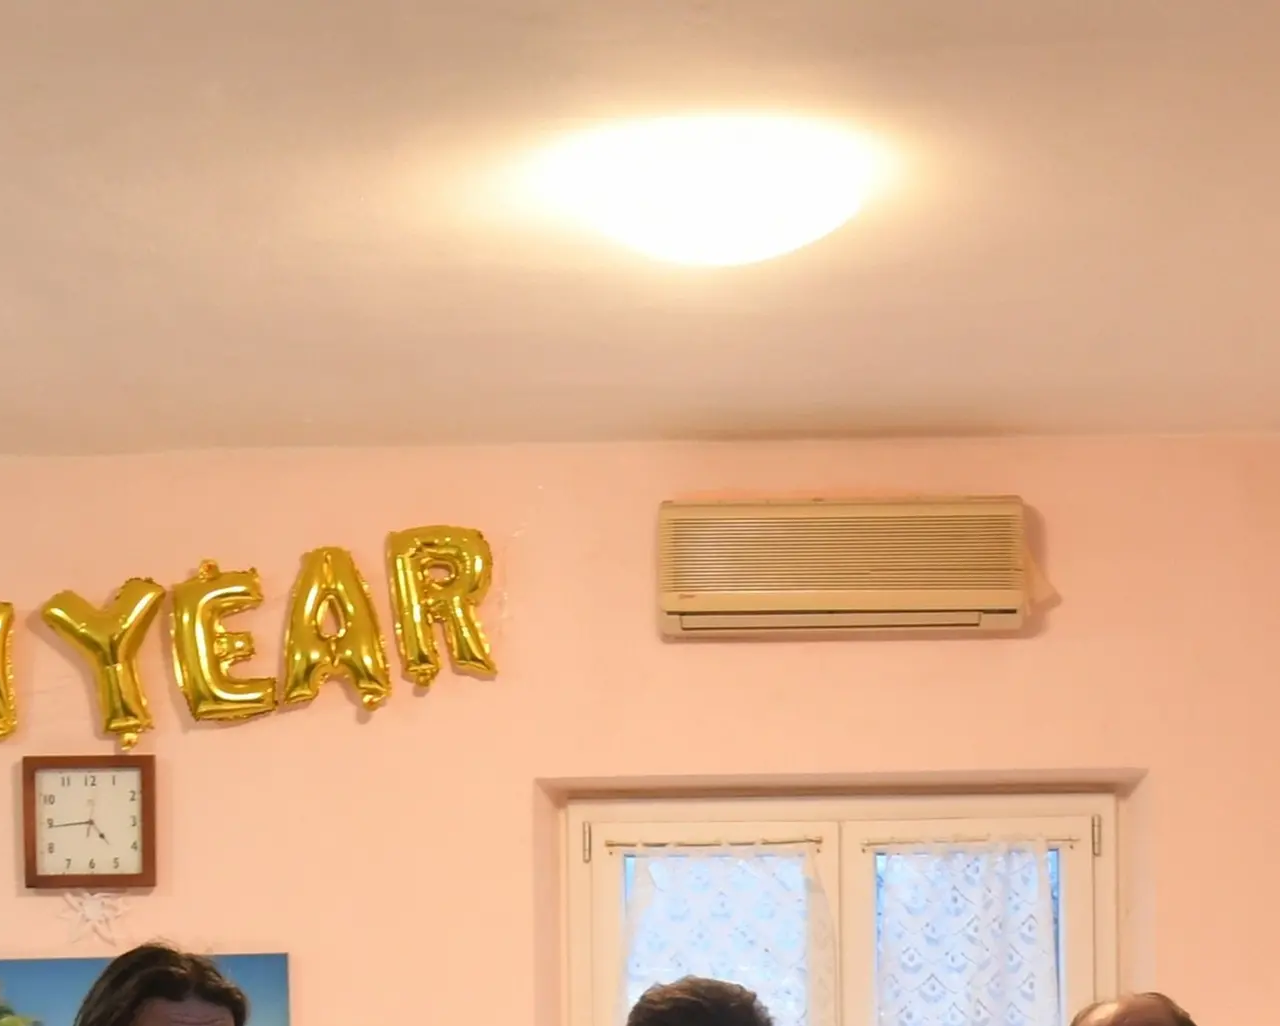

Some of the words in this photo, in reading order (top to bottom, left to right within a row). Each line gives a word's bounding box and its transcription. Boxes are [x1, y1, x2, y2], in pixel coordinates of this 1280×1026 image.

[40, 525, 498, 751] YEAR
[61, 775, 71, 787] 11
[84, 775, 97, 787] 12
[43, 794, 56, 805] 10
